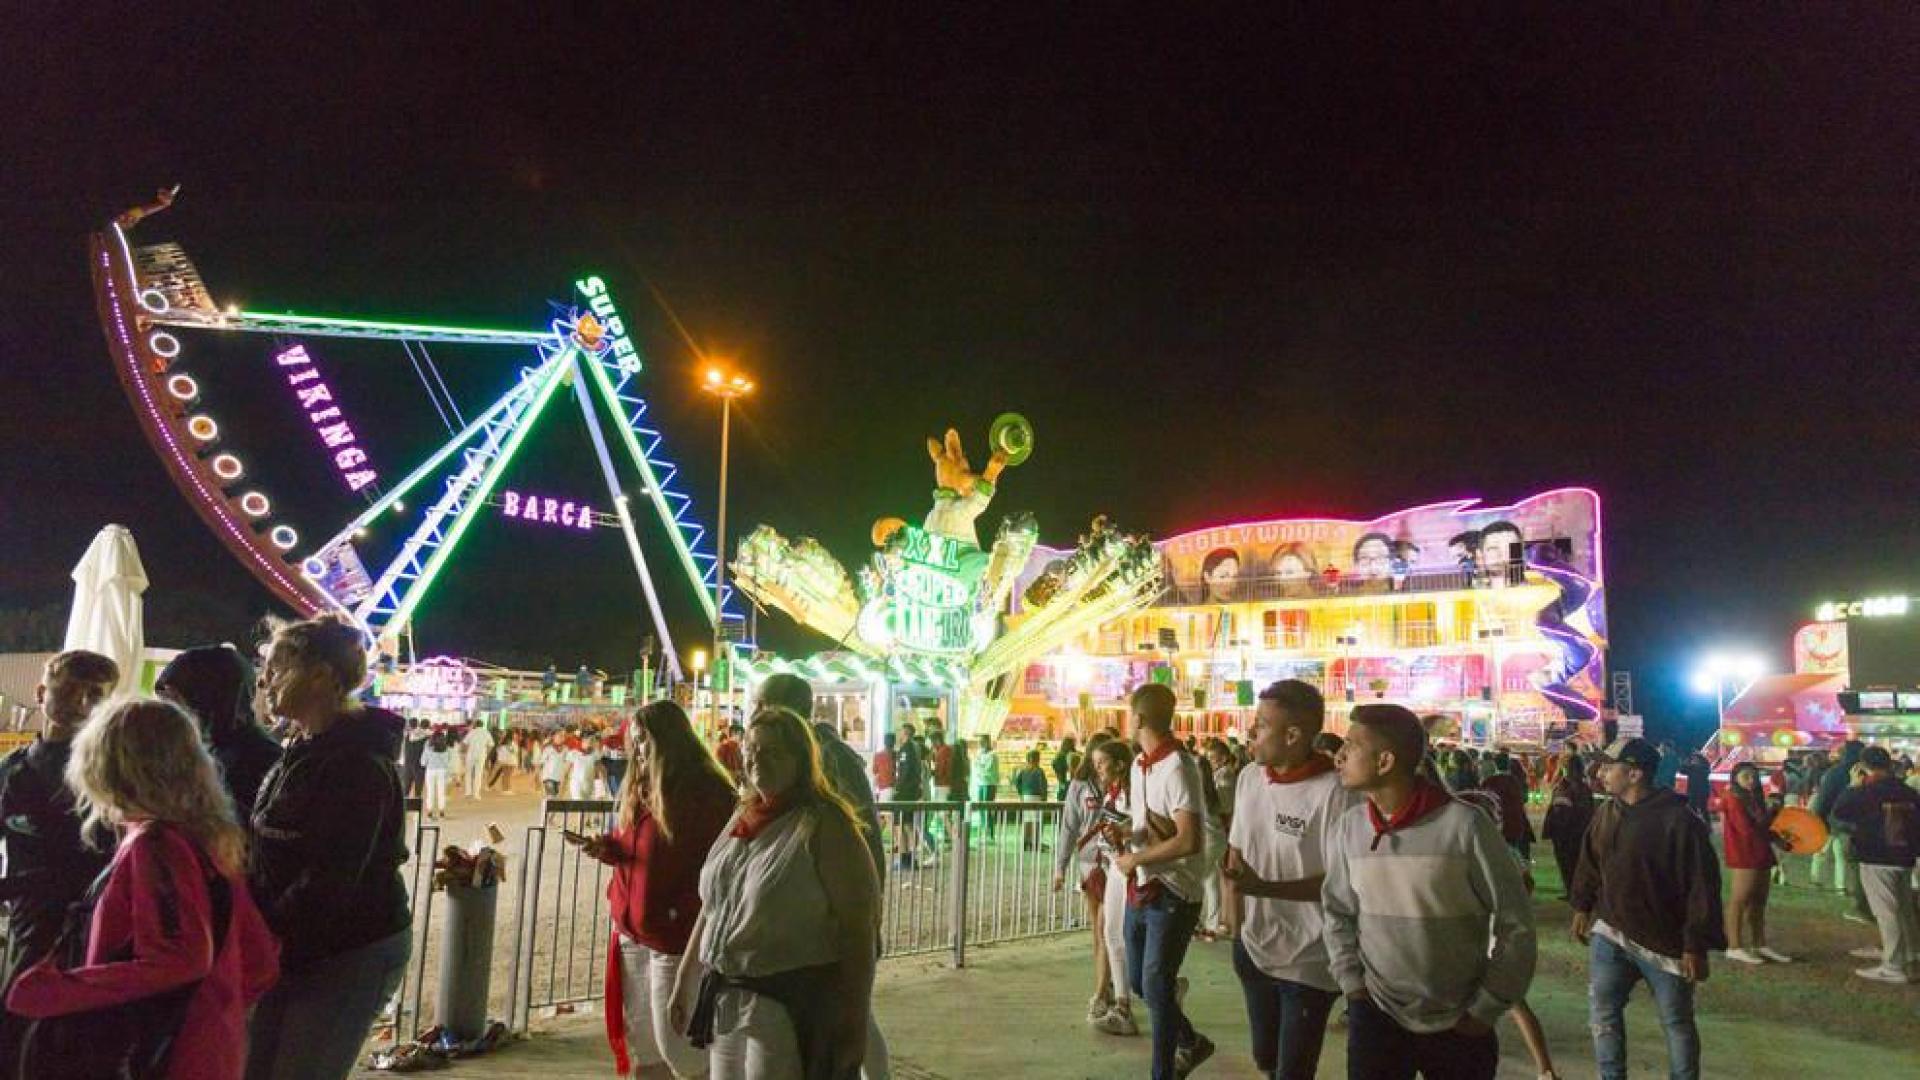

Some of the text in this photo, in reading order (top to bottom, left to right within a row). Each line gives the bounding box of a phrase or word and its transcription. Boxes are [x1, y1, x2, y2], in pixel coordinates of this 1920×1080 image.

[576, 276, 642, 377] SUPER
[277, 344, 378, 491] VIKINGA
[503, 490, 592, 529] BARCA
[901, 526, 960, 569] XXL
[1275, 813, 1306, 829] NASA
